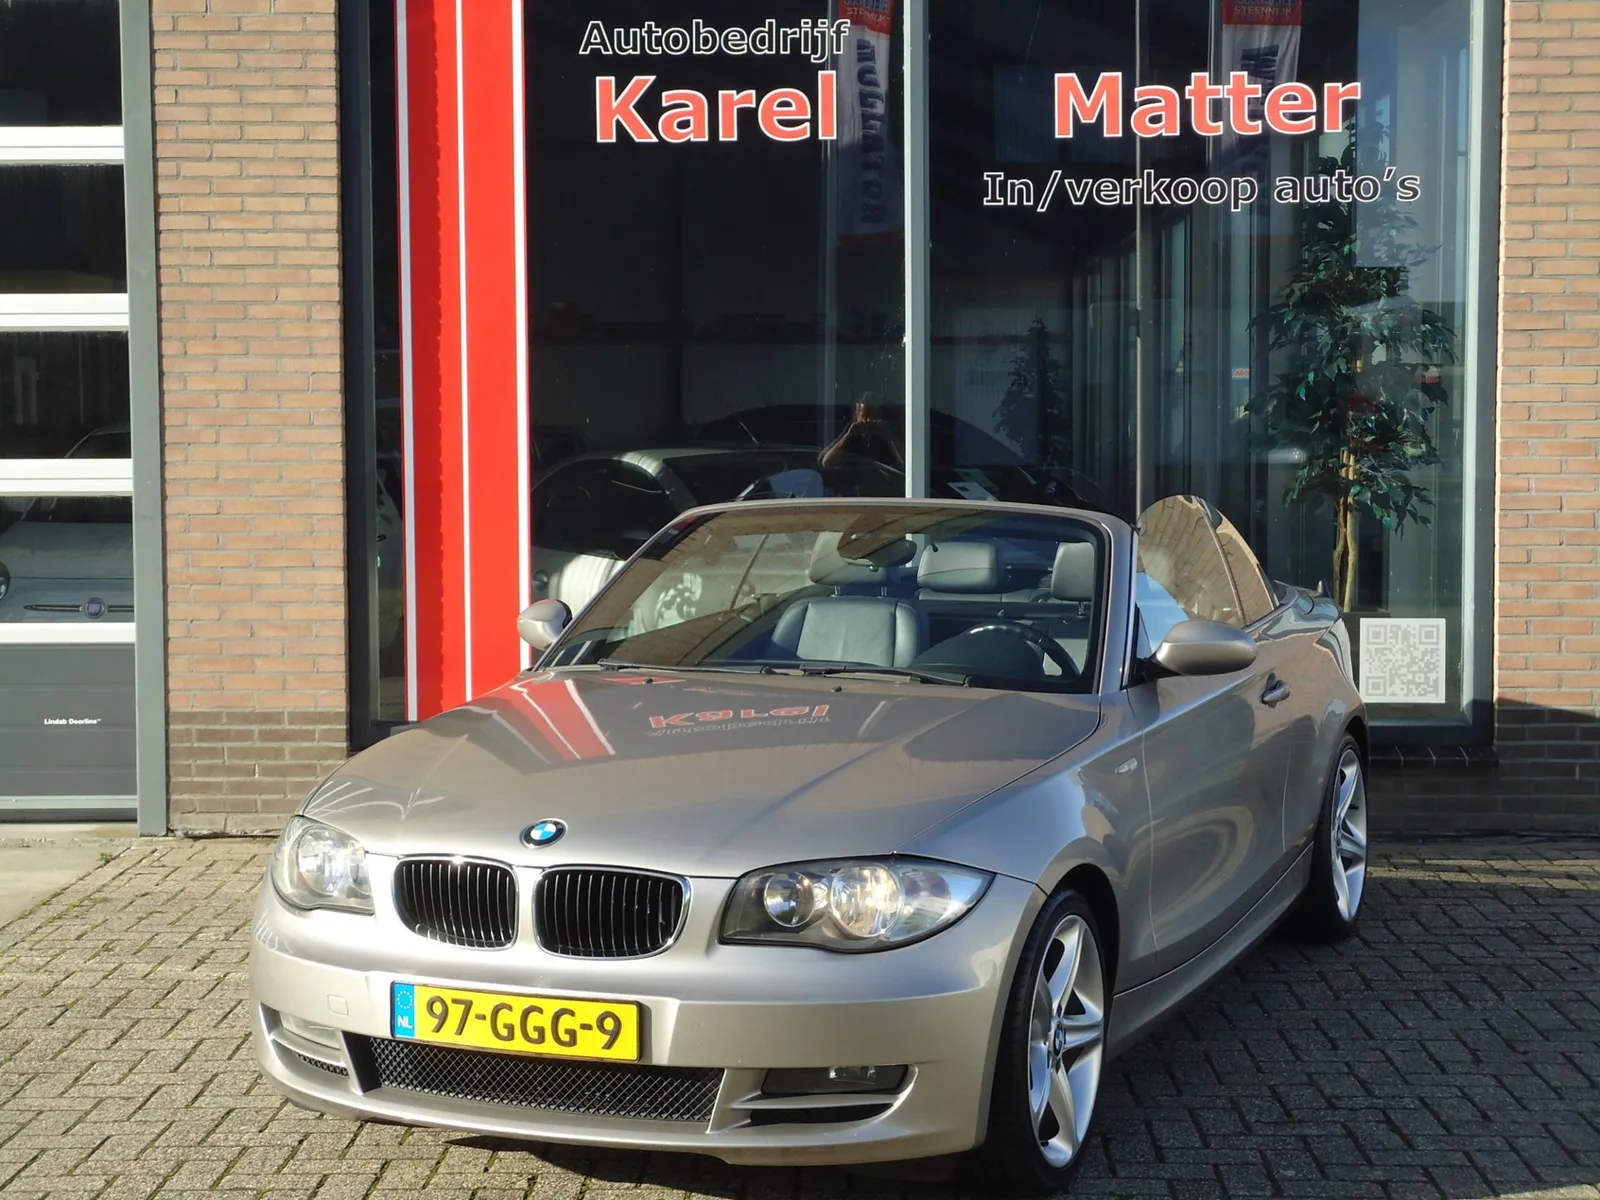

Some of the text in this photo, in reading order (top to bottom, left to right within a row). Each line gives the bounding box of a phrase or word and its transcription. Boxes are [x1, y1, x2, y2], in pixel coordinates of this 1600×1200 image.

[579, 19, 850, 63] Autobedrijf
[595, 71, 838, 143] Karel
[1054, 71, 1362, 139] Matter
[983, 167, 1421, 213] In/verkoop auto's
[397, 1015, 413, 1029] NL
[426, 995, 623, 1051] 97-GGG-9
